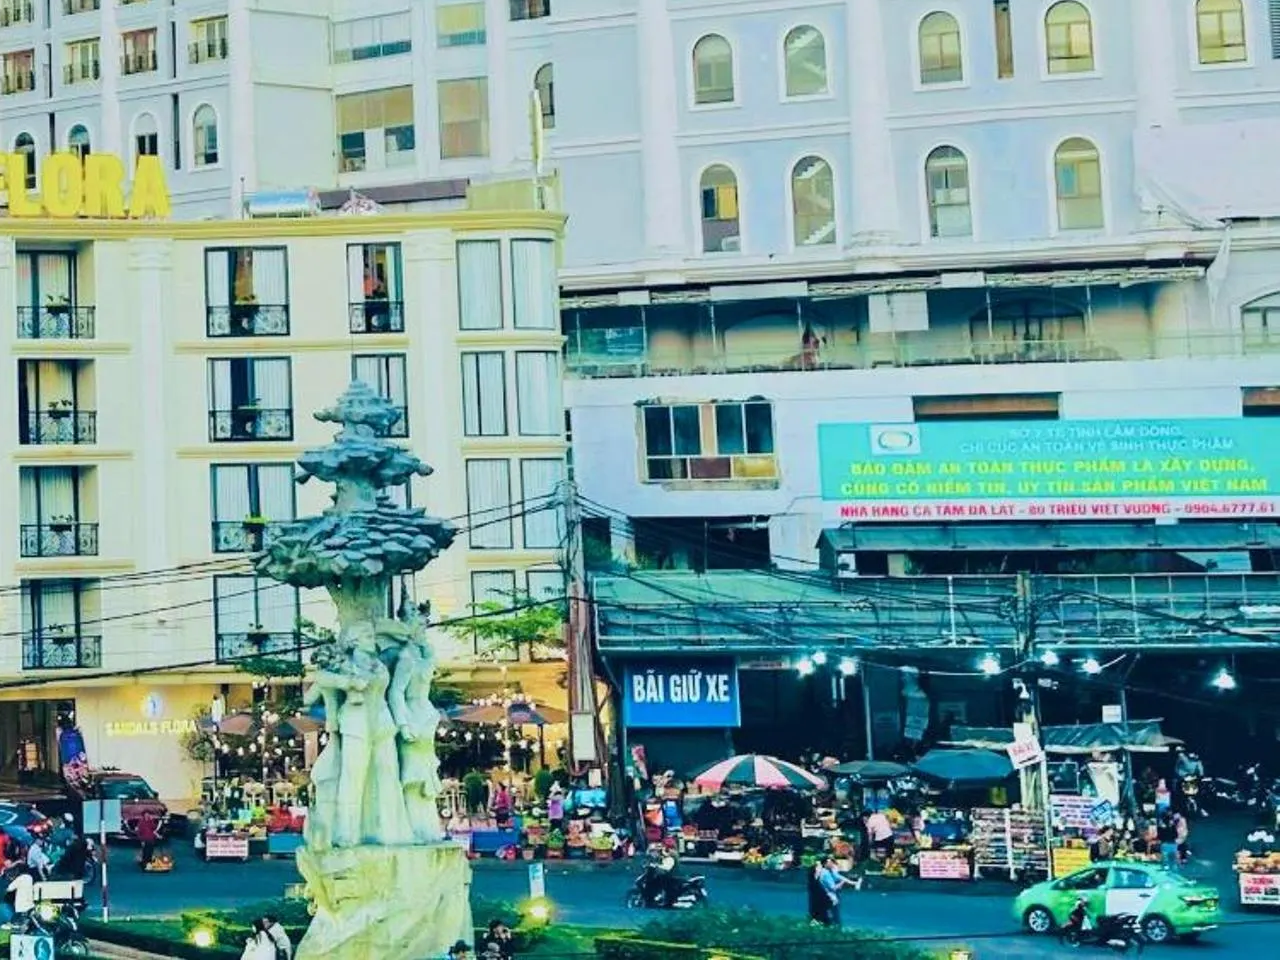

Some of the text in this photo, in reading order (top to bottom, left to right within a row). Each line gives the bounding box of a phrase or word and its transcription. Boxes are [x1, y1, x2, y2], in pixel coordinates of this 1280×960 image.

[632, 669, 730, 703] BÃI GIỮ XE
